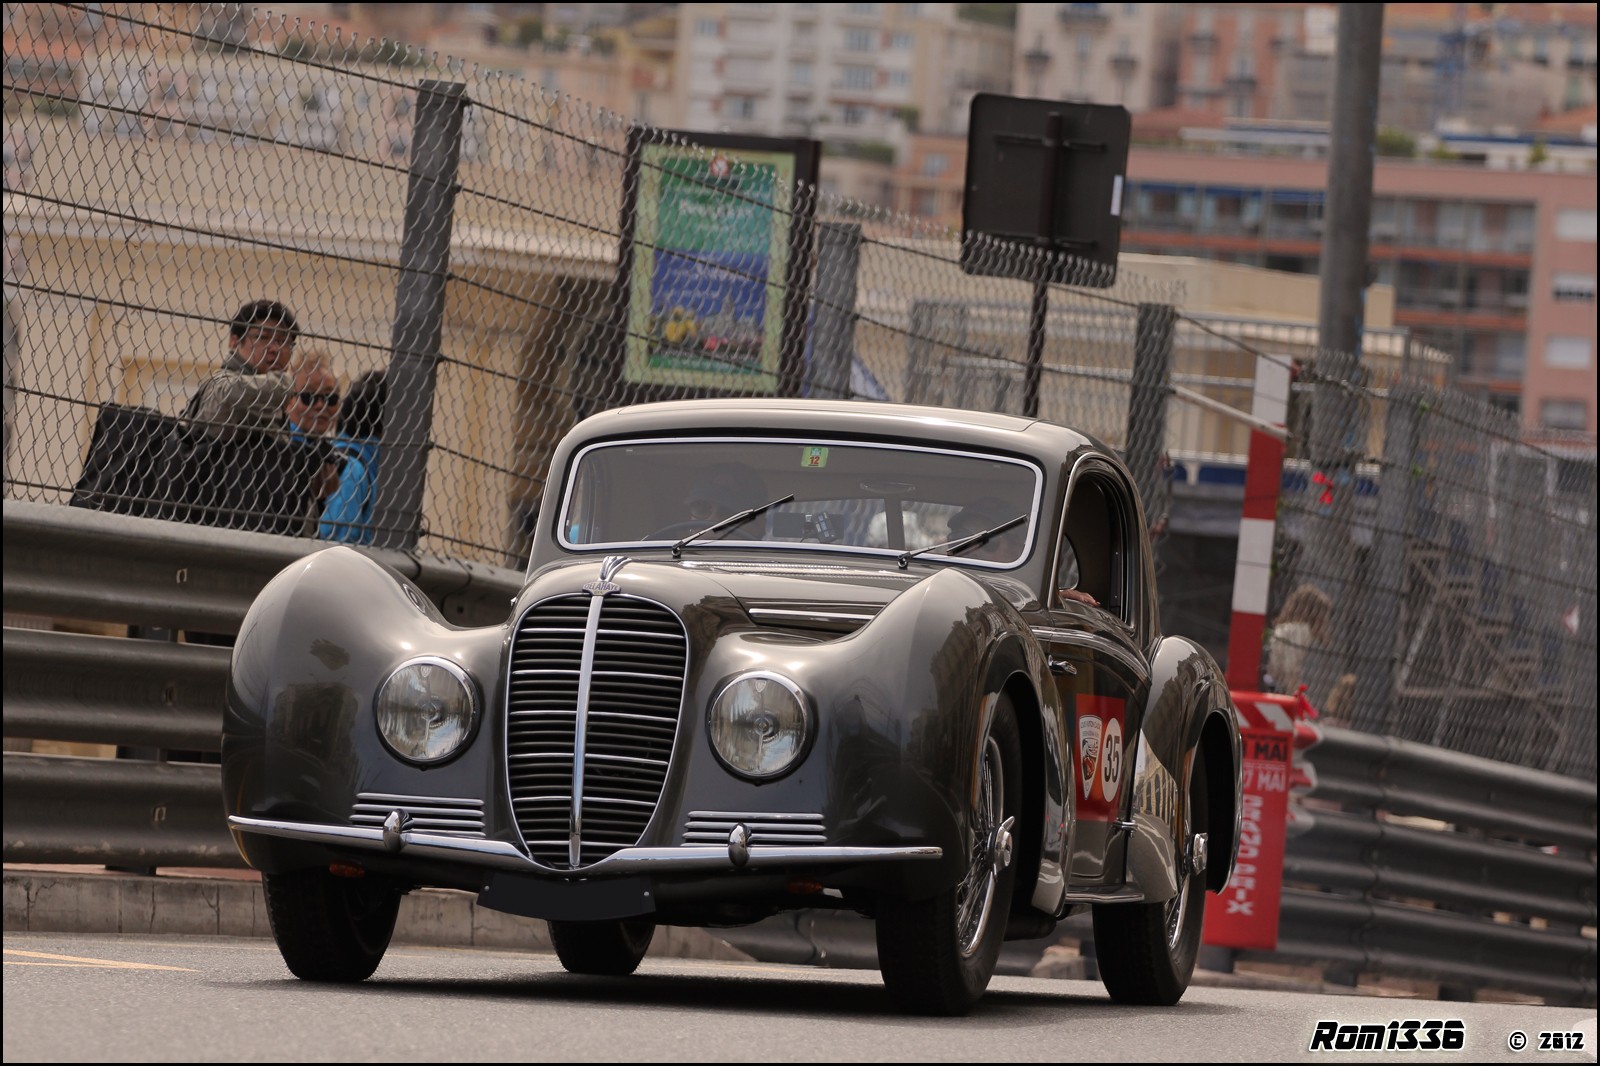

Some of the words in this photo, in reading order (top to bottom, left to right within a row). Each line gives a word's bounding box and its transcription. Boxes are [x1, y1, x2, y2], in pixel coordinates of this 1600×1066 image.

[809, 455, 820, 465] 12
[584, 582, 618, 591] DELAHAYE
[1104, 734, 1120, 783] 35
[1254, 741, 1288, 762] MAI
[1257, 769, 1286, 792] MAI
